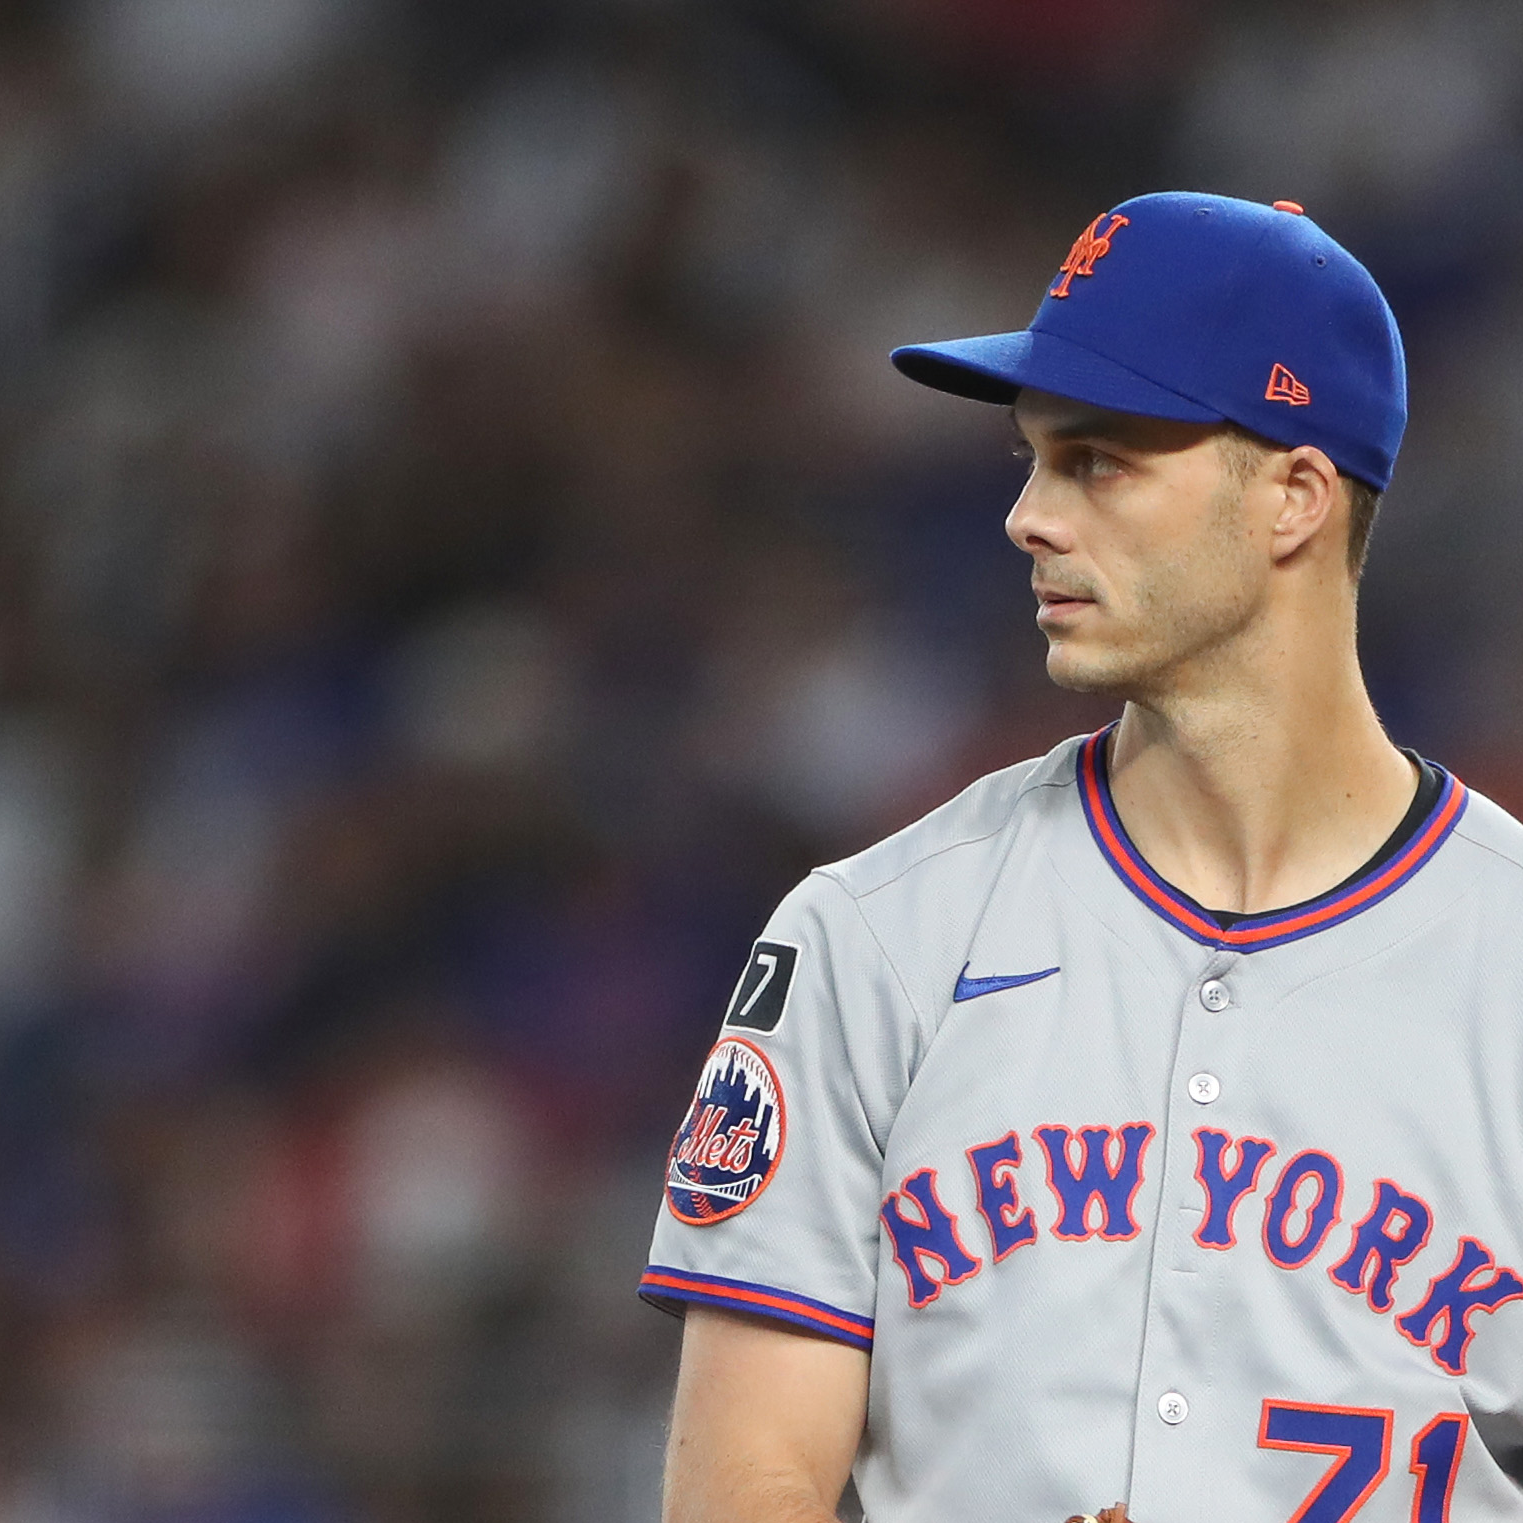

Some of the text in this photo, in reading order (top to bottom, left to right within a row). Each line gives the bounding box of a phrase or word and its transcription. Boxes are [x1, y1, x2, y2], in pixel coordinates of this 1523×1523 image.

[740, 954, 777, 1016] 7
[678, 1104, 760, 1174] Mets
[880, 1121, 1156, 1309] NEW
